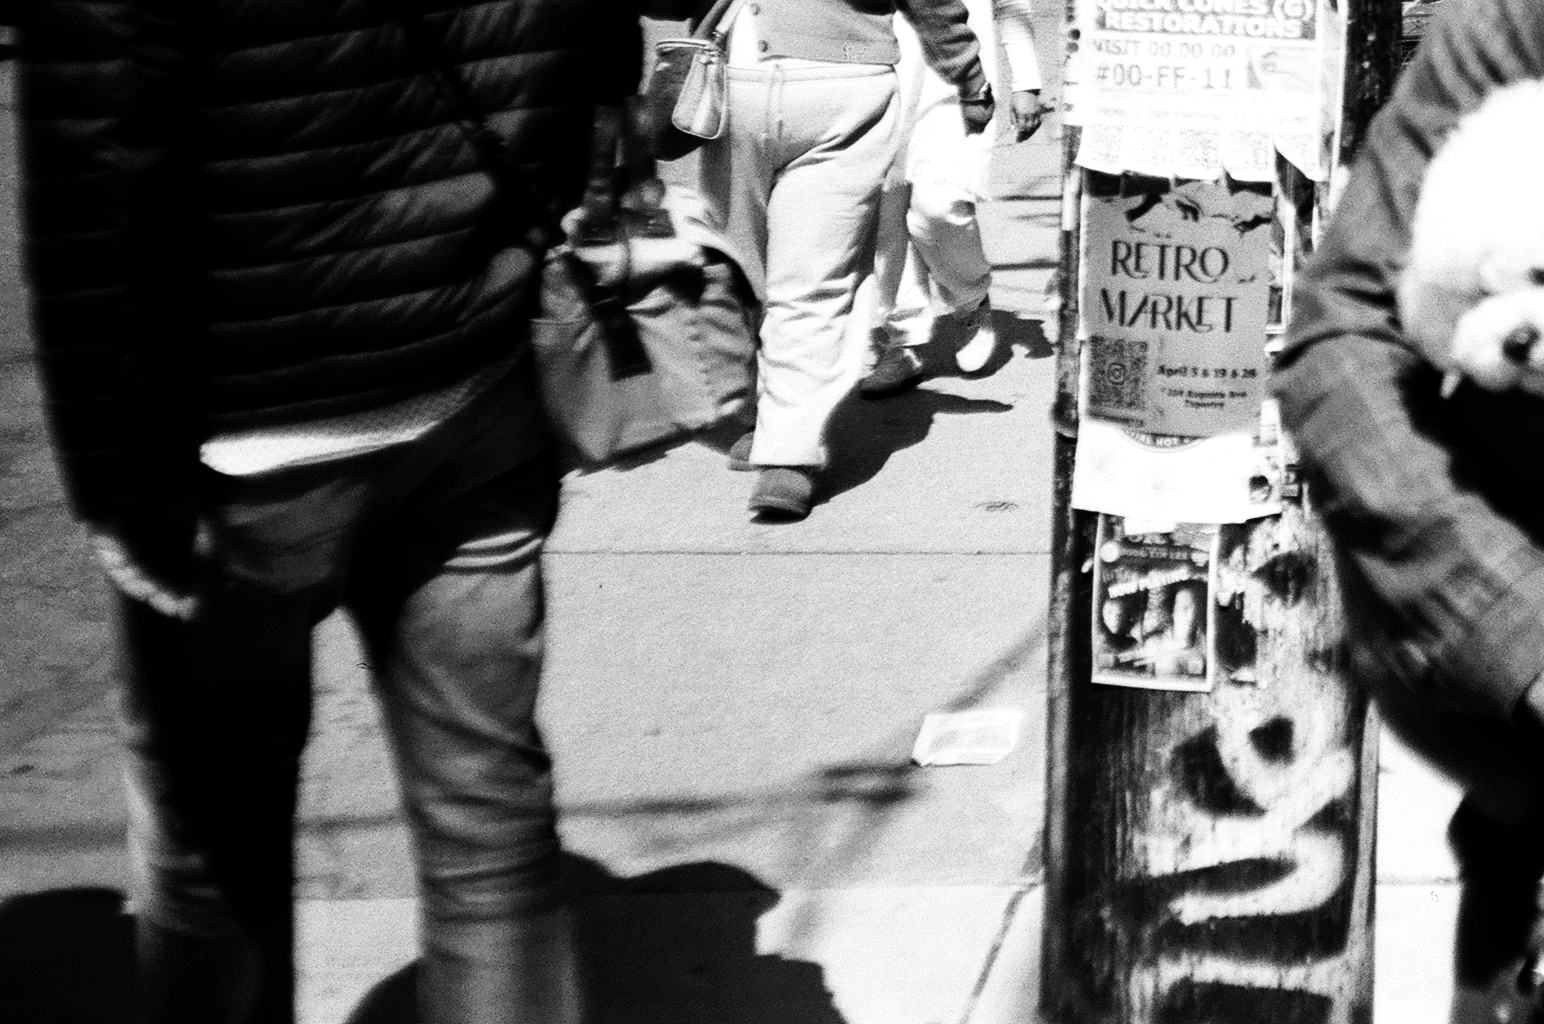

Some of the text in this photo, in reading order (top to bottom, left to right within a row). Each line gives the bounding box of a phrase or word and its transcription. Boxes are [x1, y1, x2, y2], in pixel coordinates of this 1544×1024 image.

[1105, 11, 1302, 38] RESTORATIONS
[1093, 38, 1141, 56] VISIT
[1111, 240, 1230, 284] RETRO
[1101, 288, 1238, 333] MARKET
